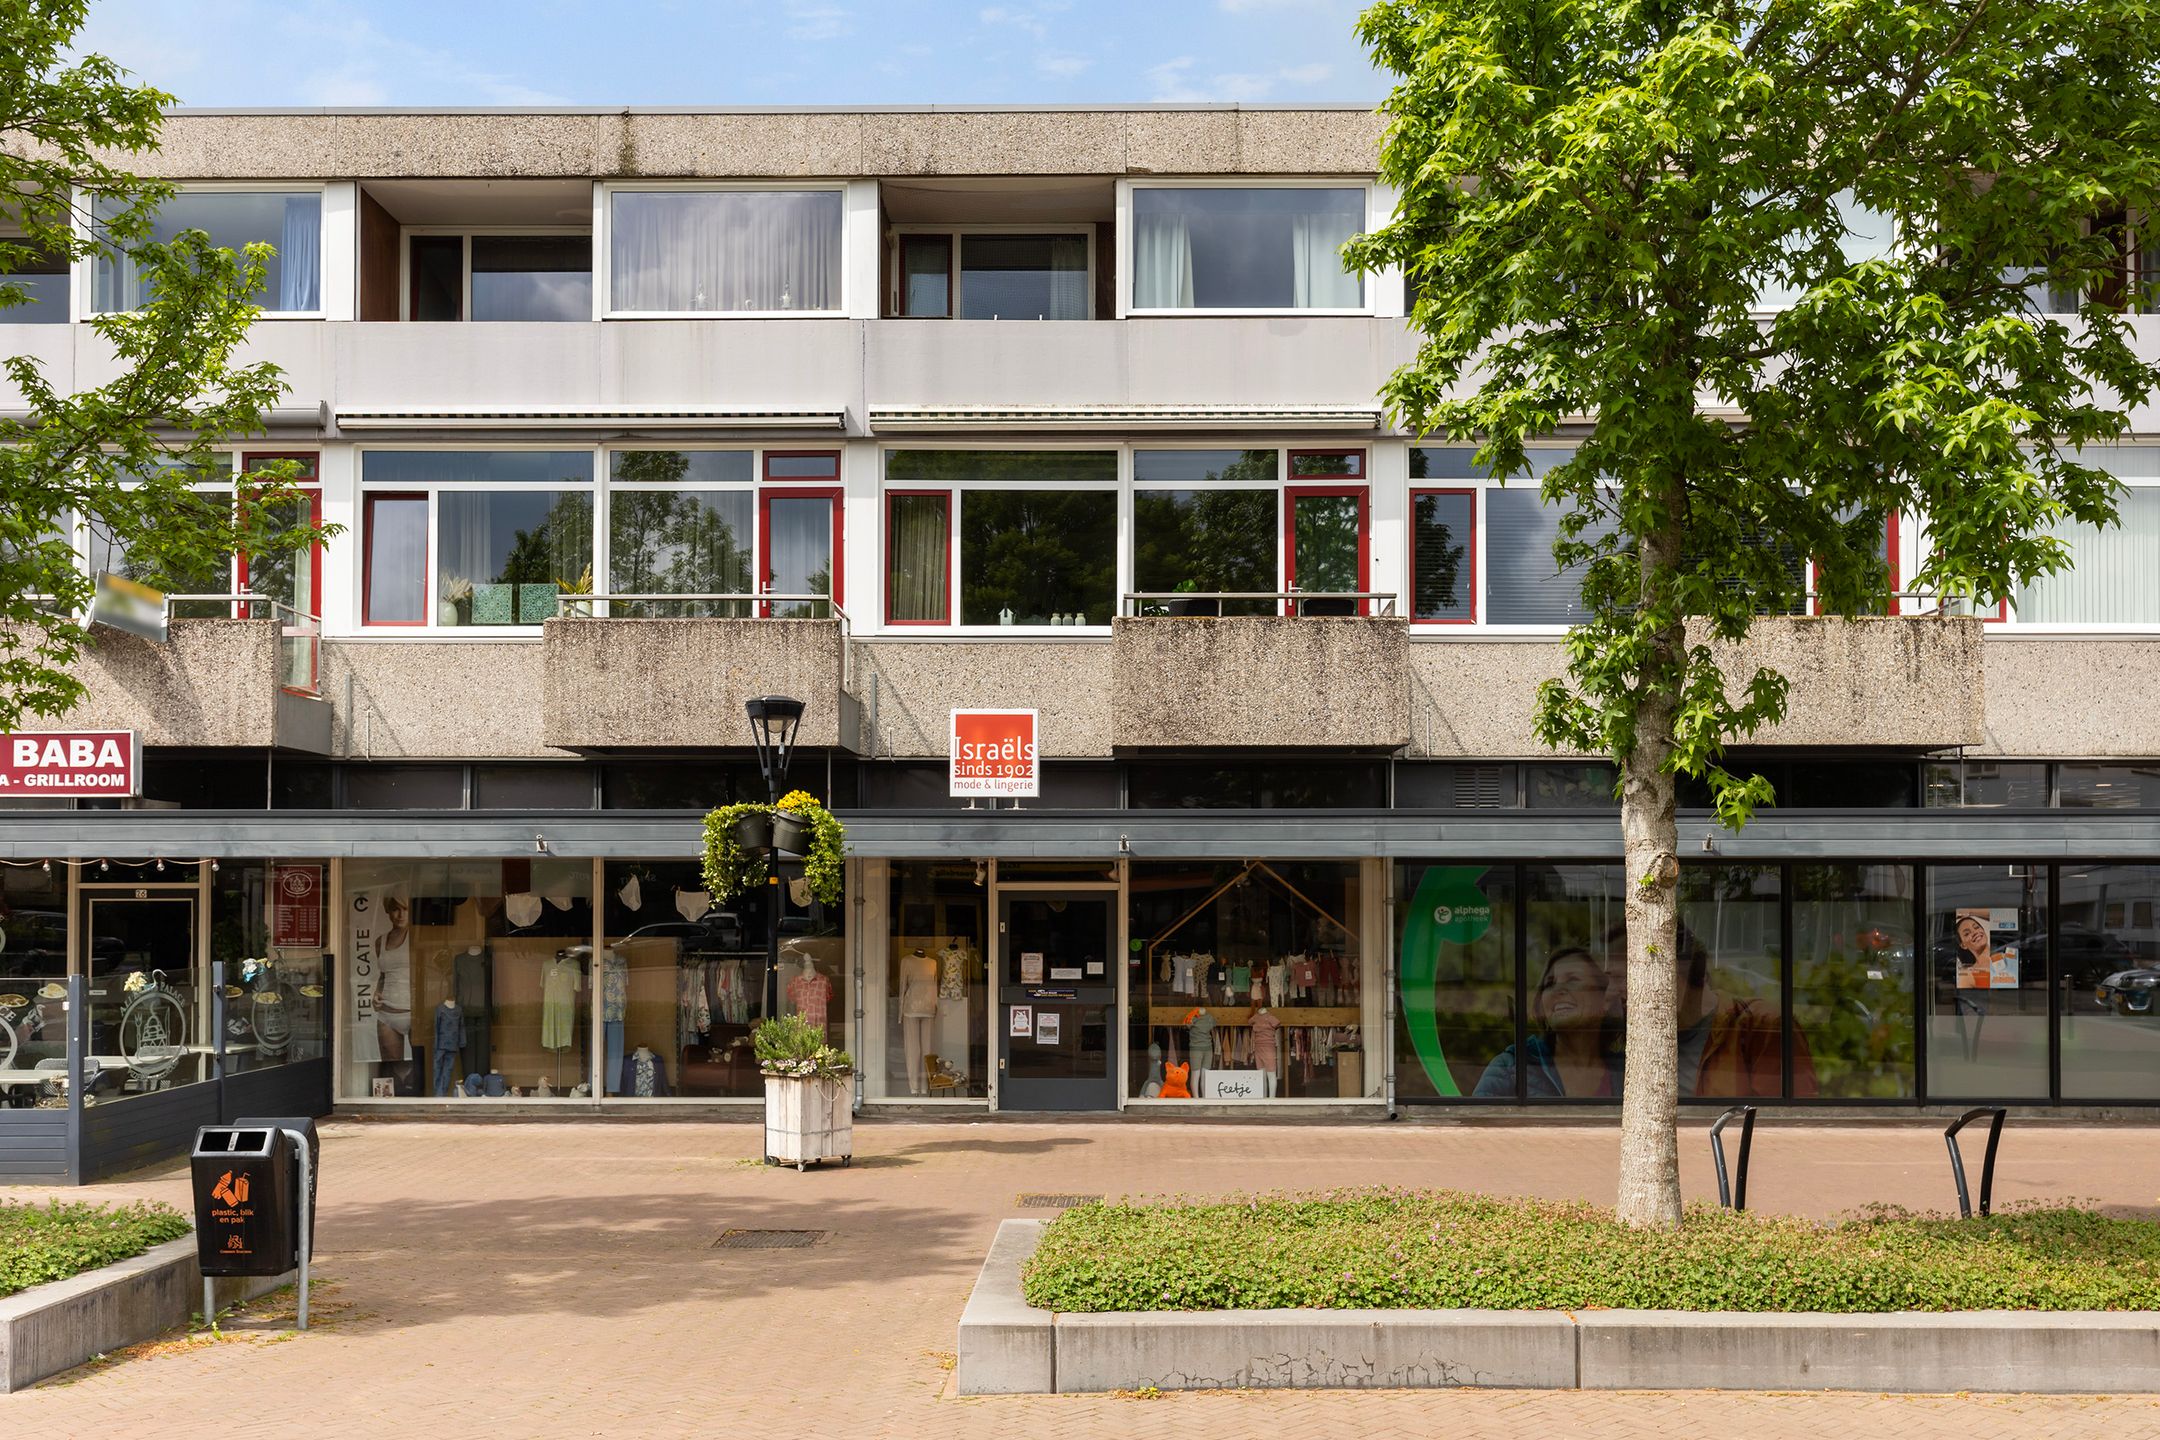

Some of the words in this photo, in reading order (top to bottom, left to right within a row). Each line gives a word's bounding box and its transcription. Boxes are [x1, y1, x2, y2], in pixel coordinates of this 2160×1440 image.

[13, 739, 125, 767] BABA
[955, 736, 1034, 761] Israëls
[955, 760, 992, 776] sinds
[996, 764, 1033, 779] 1902
[24, 774, 125, 787] GRILLROOM
[954, 779, 982, 789] mode
[984, 779, 991, 789] &
[994, 779, 1033, 792] lingerie
[1454, 906, 1490, 916] alphega
[356, 928, 370, 977] CATE
[160, 981, 186, 1007] PALACE
[357, 984, 371, 1021] TEN
[1217, 1081, 1252, 1098] feetje
[211, 1208, 239, 1217] plastic,
